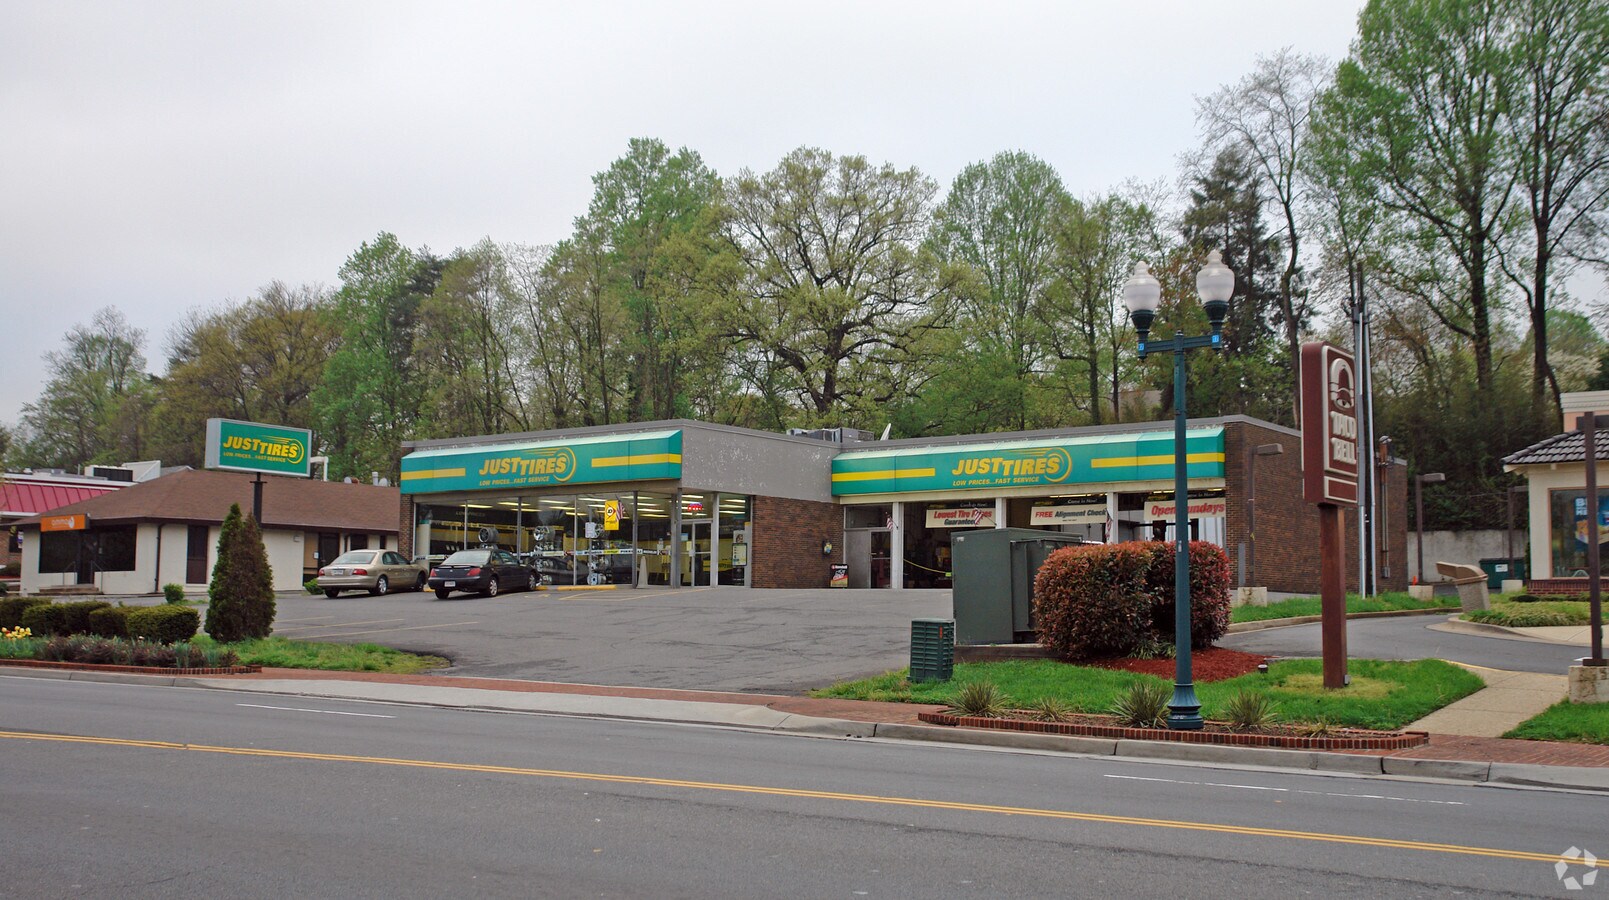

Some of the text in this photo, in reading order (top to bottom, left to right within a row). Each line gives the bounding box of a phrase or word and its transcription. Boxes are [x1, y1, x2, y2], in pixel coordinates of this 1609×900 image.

[1330, 410, 1357, 439] TACO
[1331, 437, 1357, 464] BELL
[933, 511, 957, 519] Lowest
[958, 510, 970, 518] Tire
[1055, 510, 1086, 518] Alignment
[1151, 503, 1225, 517] Open undays
